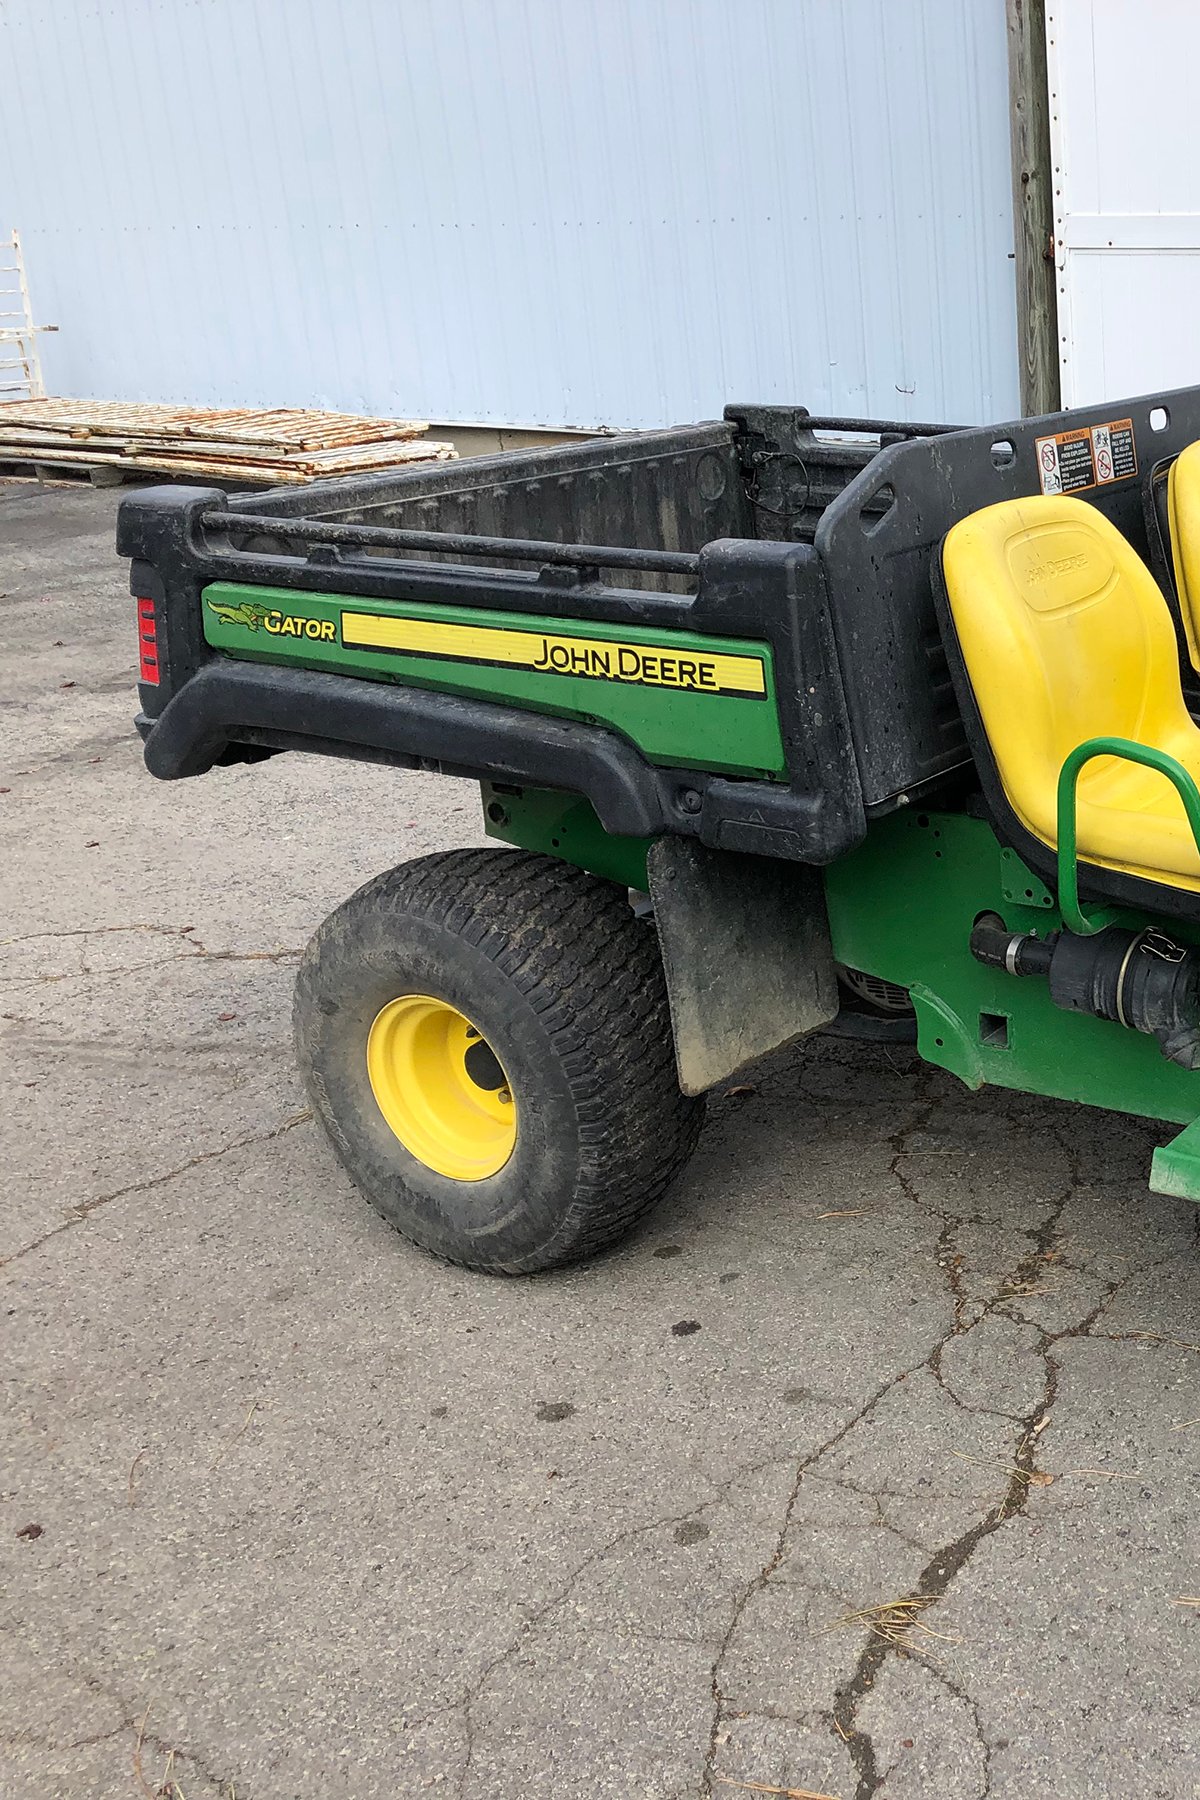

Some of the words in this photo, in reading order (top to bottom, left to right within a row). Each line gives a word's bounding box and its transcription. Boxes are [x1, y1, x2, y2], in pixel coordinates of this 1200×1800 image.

[1066, 431, 1085, 441] WARNING
[264, 610, 337, 642] GATOR
[533, 639, 611, 675] JOHN
[618, 648, 717, 688] DEERE
